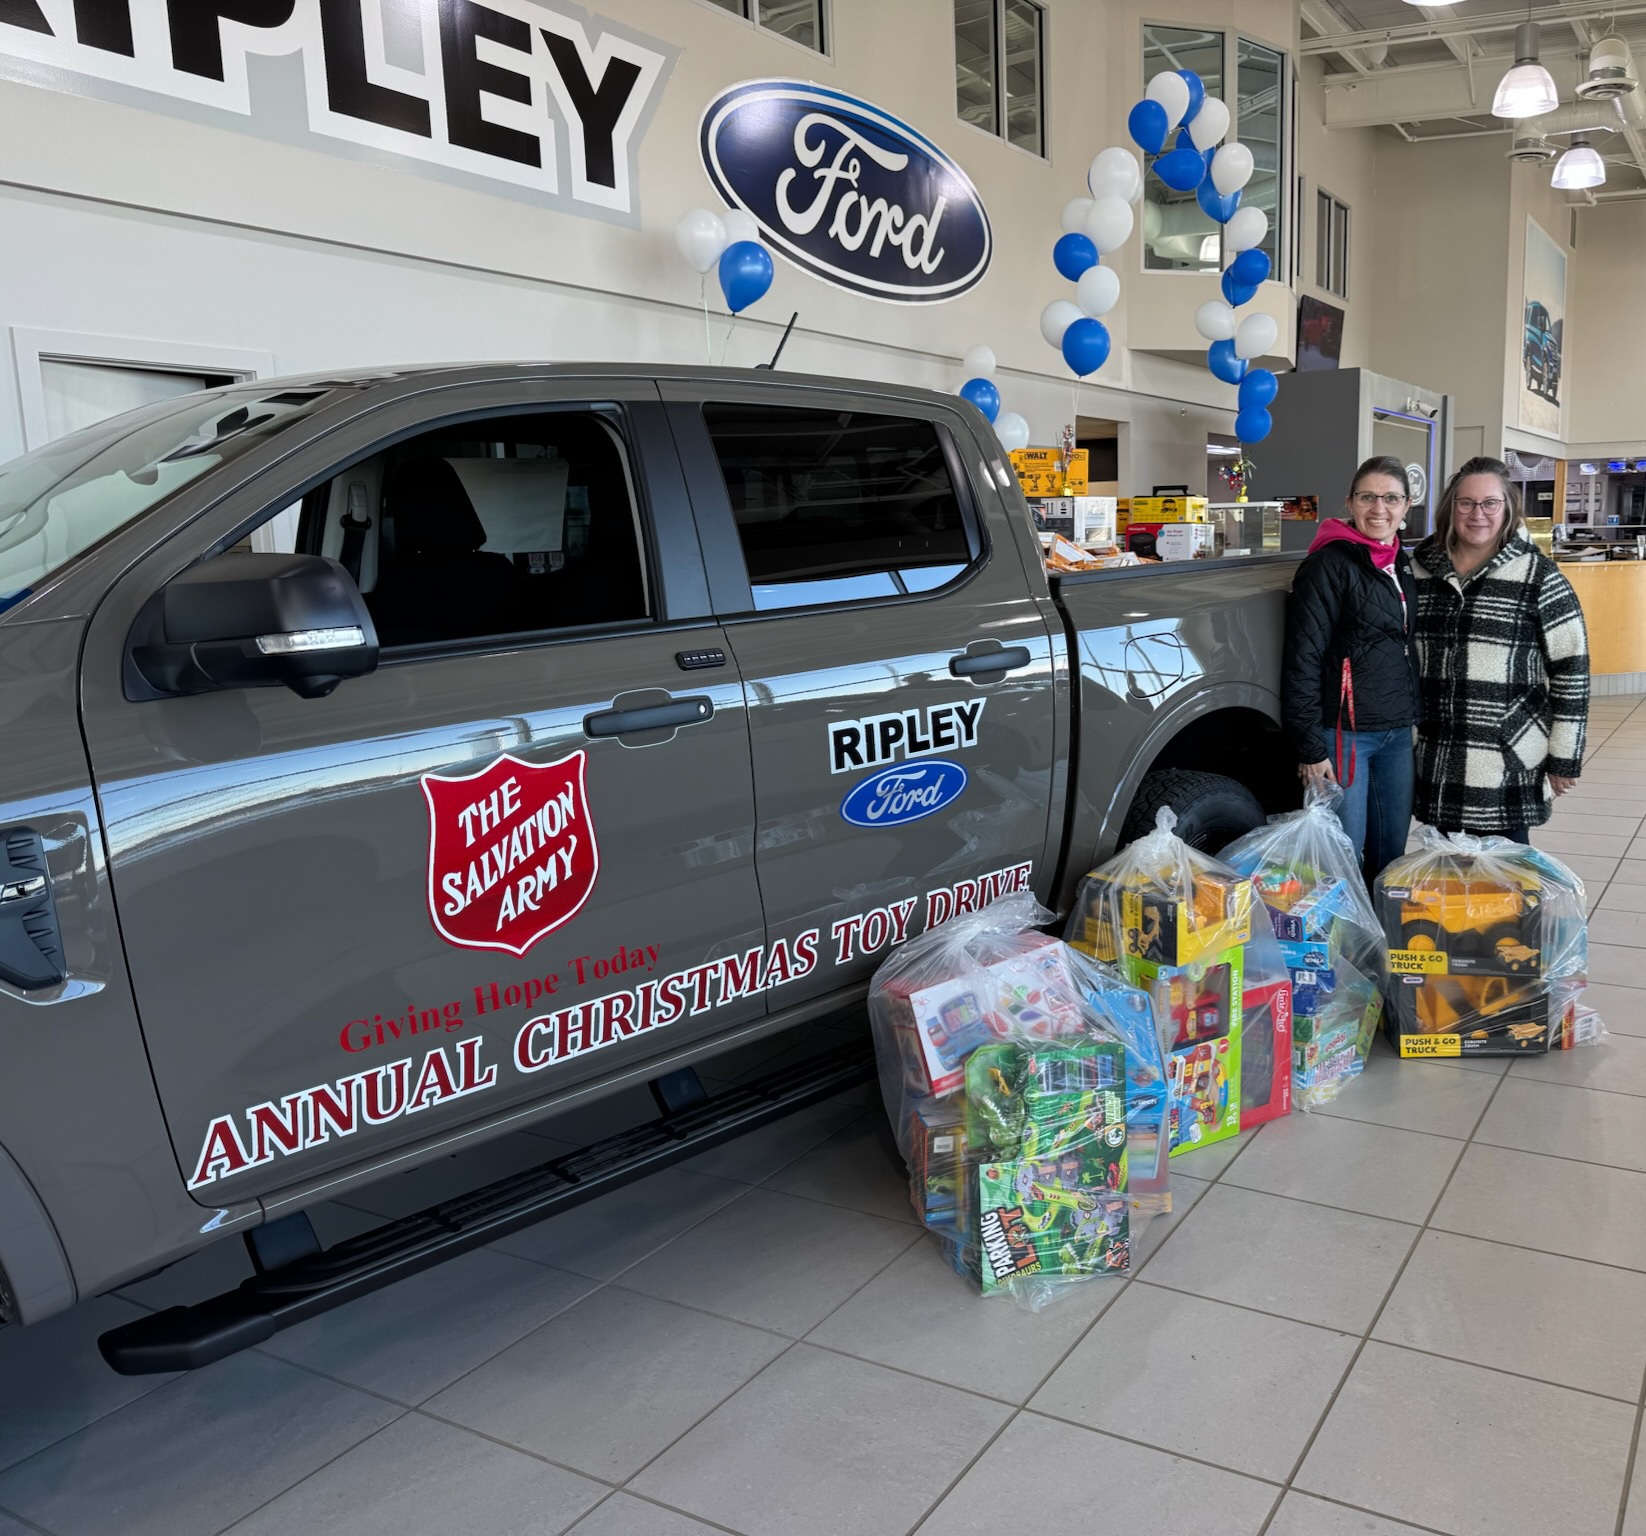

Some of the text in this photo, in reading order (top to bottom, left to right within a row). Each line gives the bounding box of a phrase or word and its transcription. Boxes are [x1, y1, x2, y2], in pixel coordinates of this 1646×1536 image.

[0, 0, 642, 190] PLEY
[775, 112, 947, 275] Ford
[831, 700, 984, 772] RIPLEY
[458, 776, 521, 848] THE
[866, 769, 946, 820] Ford
[442, 781, 576, 917] SALVATION
[496, 834, 578, 932] ARMY
[1390, 953, 1417, 962] PUSH
[1428, 955, 1443, 963] GO
[1390, 962, 1424, 970] TRUCK
[187, 860, 1033, 1190] ANNUAL CHRISTMAS TOY DRIVE
[339, 943, 662, 1054] Giving Hope Today
[1405, 1038, 1431, 1046] PUSH
[1442, 1037, 1456, 1045] GO
[1405, 1046, 1438, 1054] TRUCK
[981, 1211, 1016, 1278] PARKING
[997, 1207, 1038, 1269] LOT
